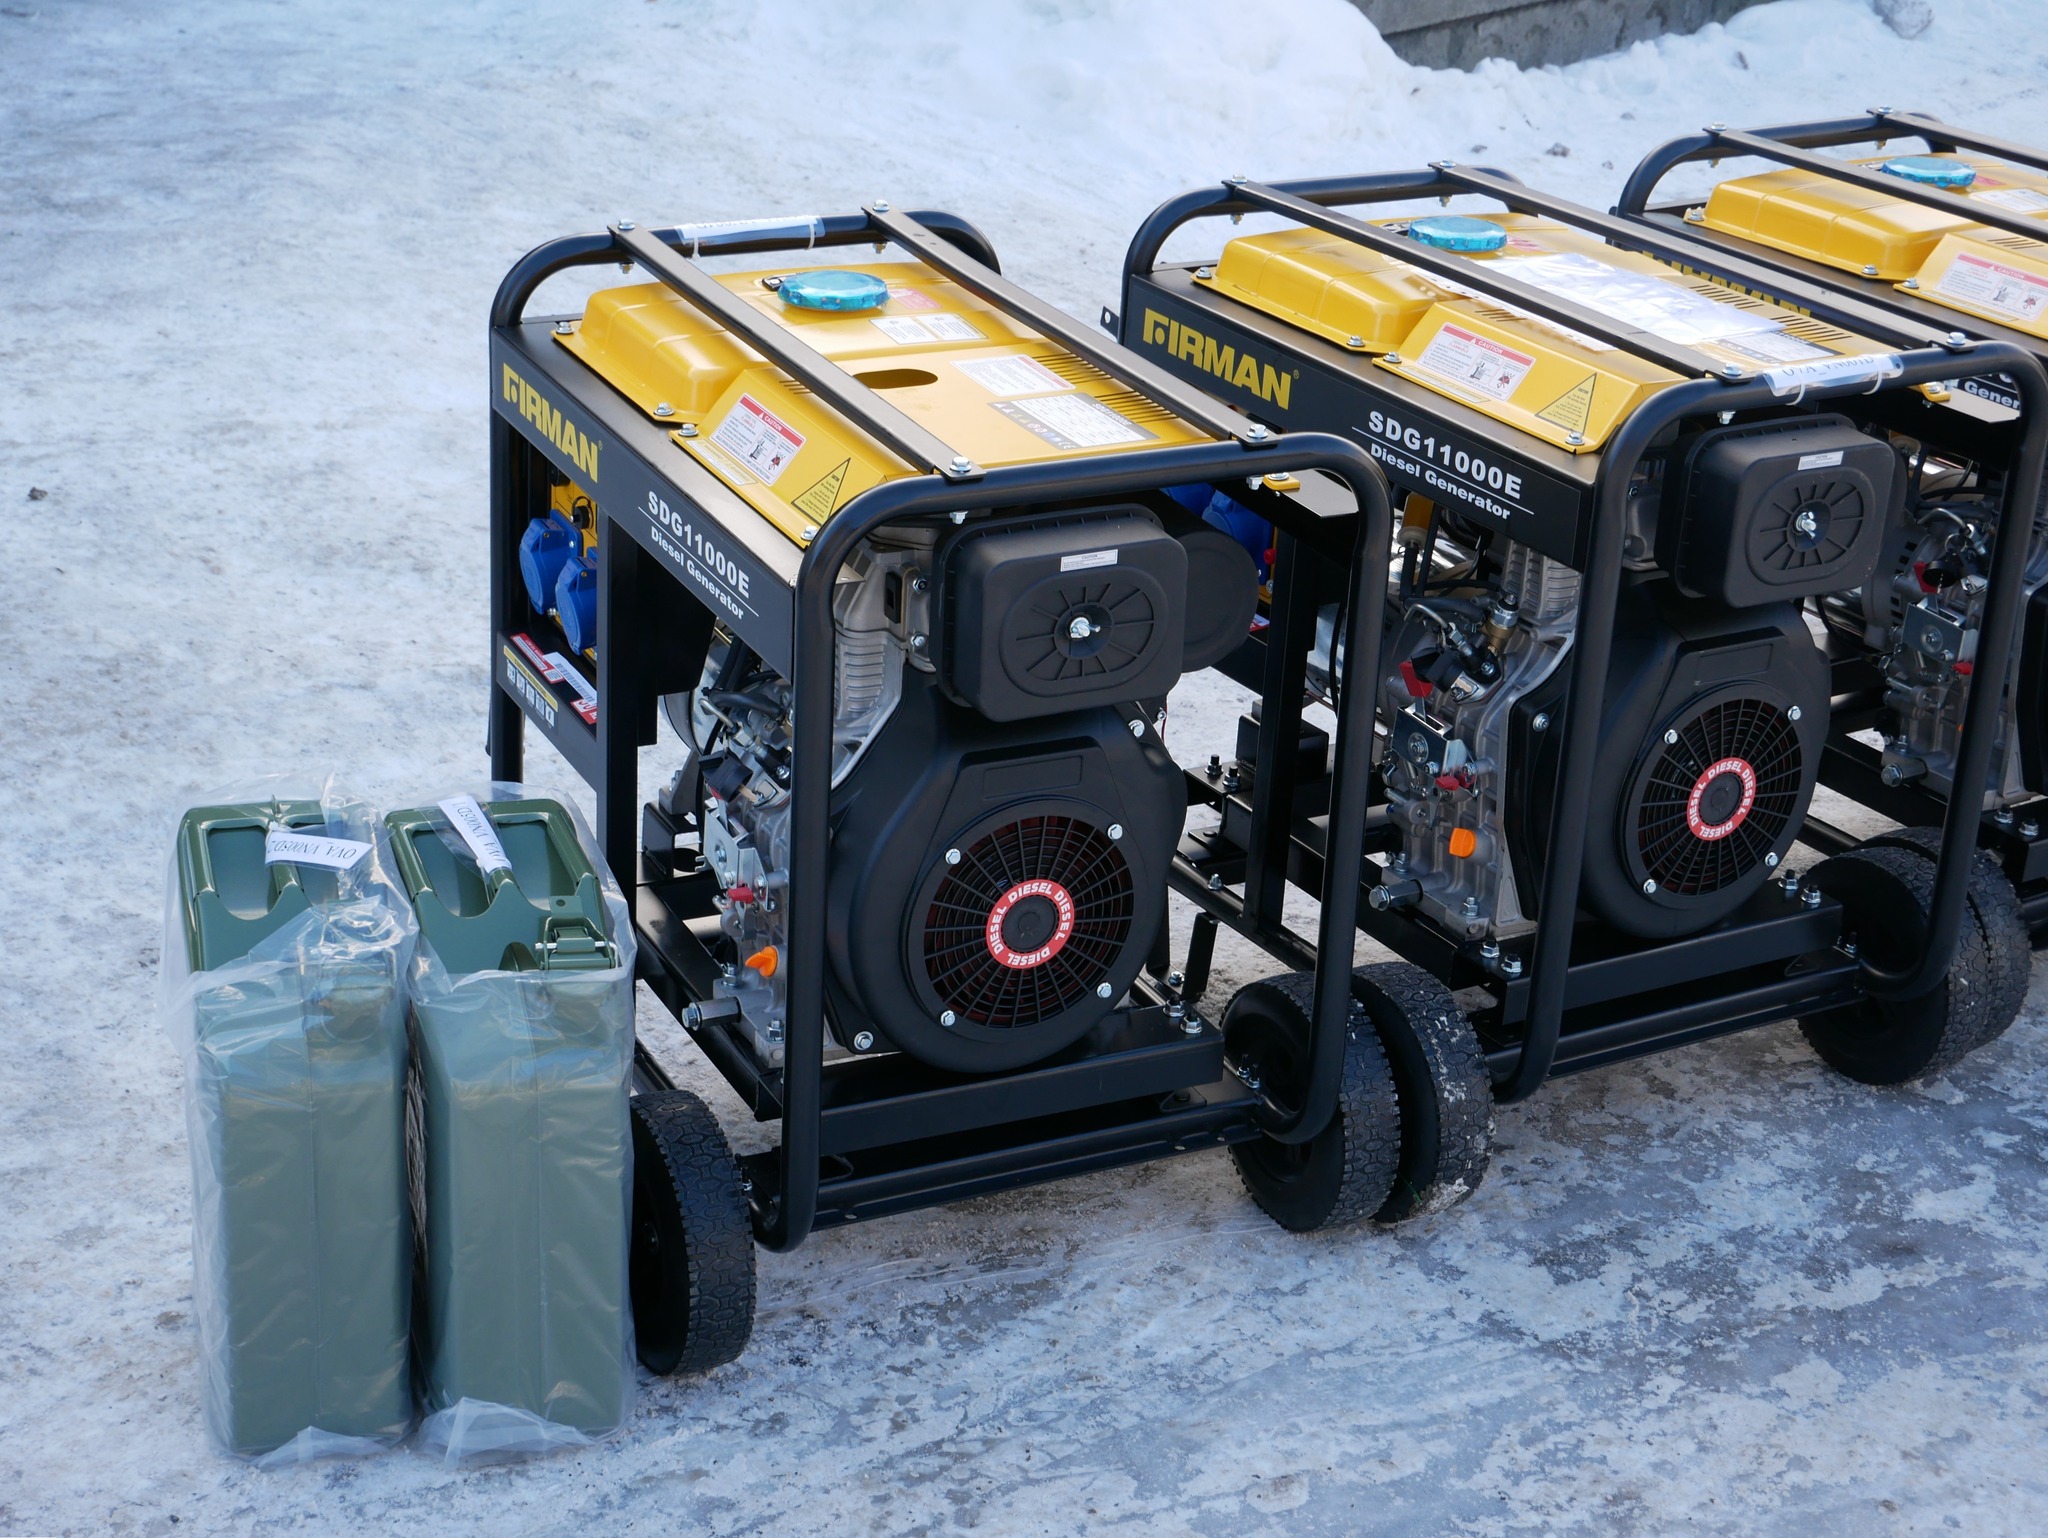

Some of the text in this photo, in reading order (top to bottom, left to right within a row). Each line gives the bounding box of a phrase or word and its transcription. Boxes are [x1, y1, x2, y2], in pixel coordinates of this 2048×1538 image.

[1478, 340, 1503, 354] CAUTION
[764, 415, 783, 431] CAUTION
[1368, 411, 1522, 499] SDG11000E
[1371, 443, 1510, 520] Diesel Generator
[648, 490, 749, 599] SDG11000E
[651, 526, 744, 620] Diesel Generator
[1708, 761, 1742, 779] DIESEL
[1737, 768, 1754, 815] DIESEL
[1690, 782, 1706, 827] DIESEL
[1699, 821, 1733, 838] DIESEL
[1008, 882, 1052, 903] DIESEL
[1054, 890, 1071, 940] DIESEL
[990, 906, 1007, 955] DIESEL
[1007, 946, 1051, 966] DIESEL
